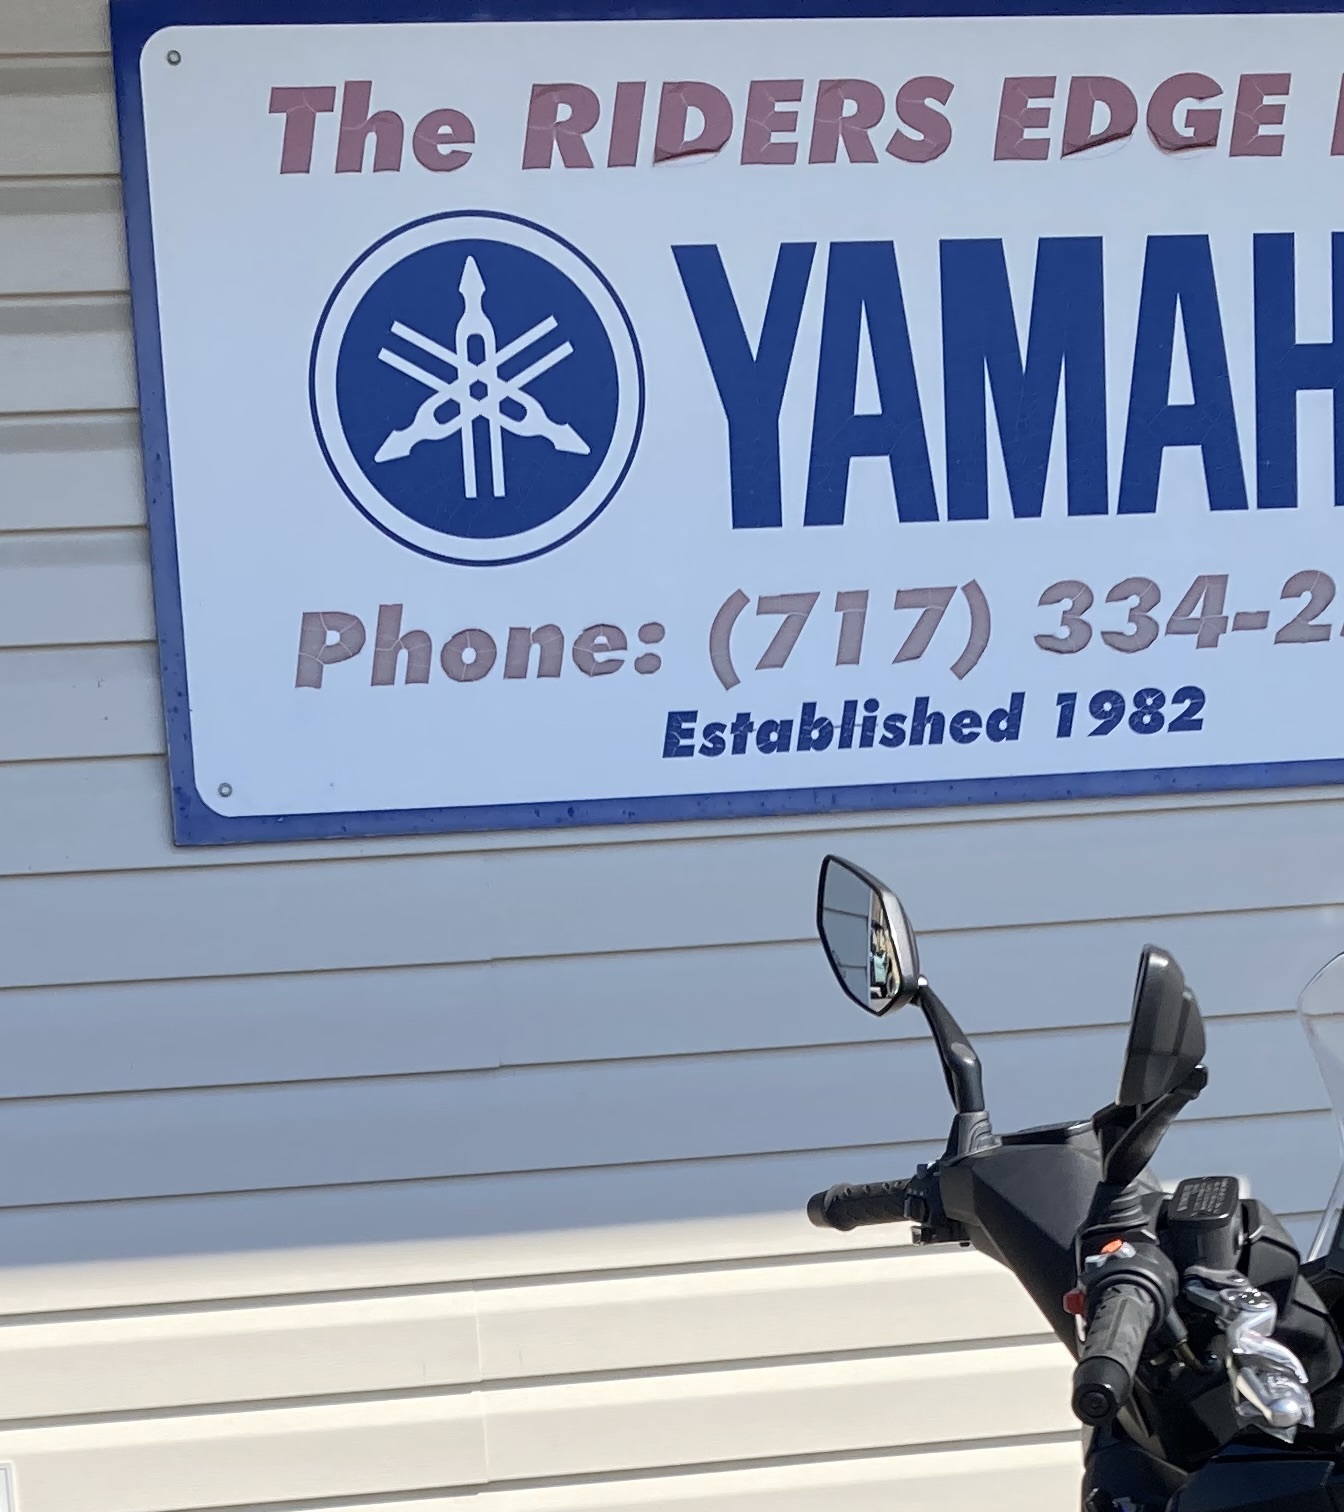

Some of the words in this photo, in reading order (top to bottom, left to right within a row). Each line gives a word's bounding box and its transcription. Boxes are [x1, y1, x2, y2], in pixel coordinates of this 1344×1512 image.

[268, 80, 476, 175] The
[521, 75, 956, 171] RIDERS
[992, 71, 1293, 162] EDGE
[294, 602, 665, 690] Phone:
[708, 578, 992, 692] (717)
[661, 694, 1027, 759] Established
[1055, 684, 1208, 740] 1982
